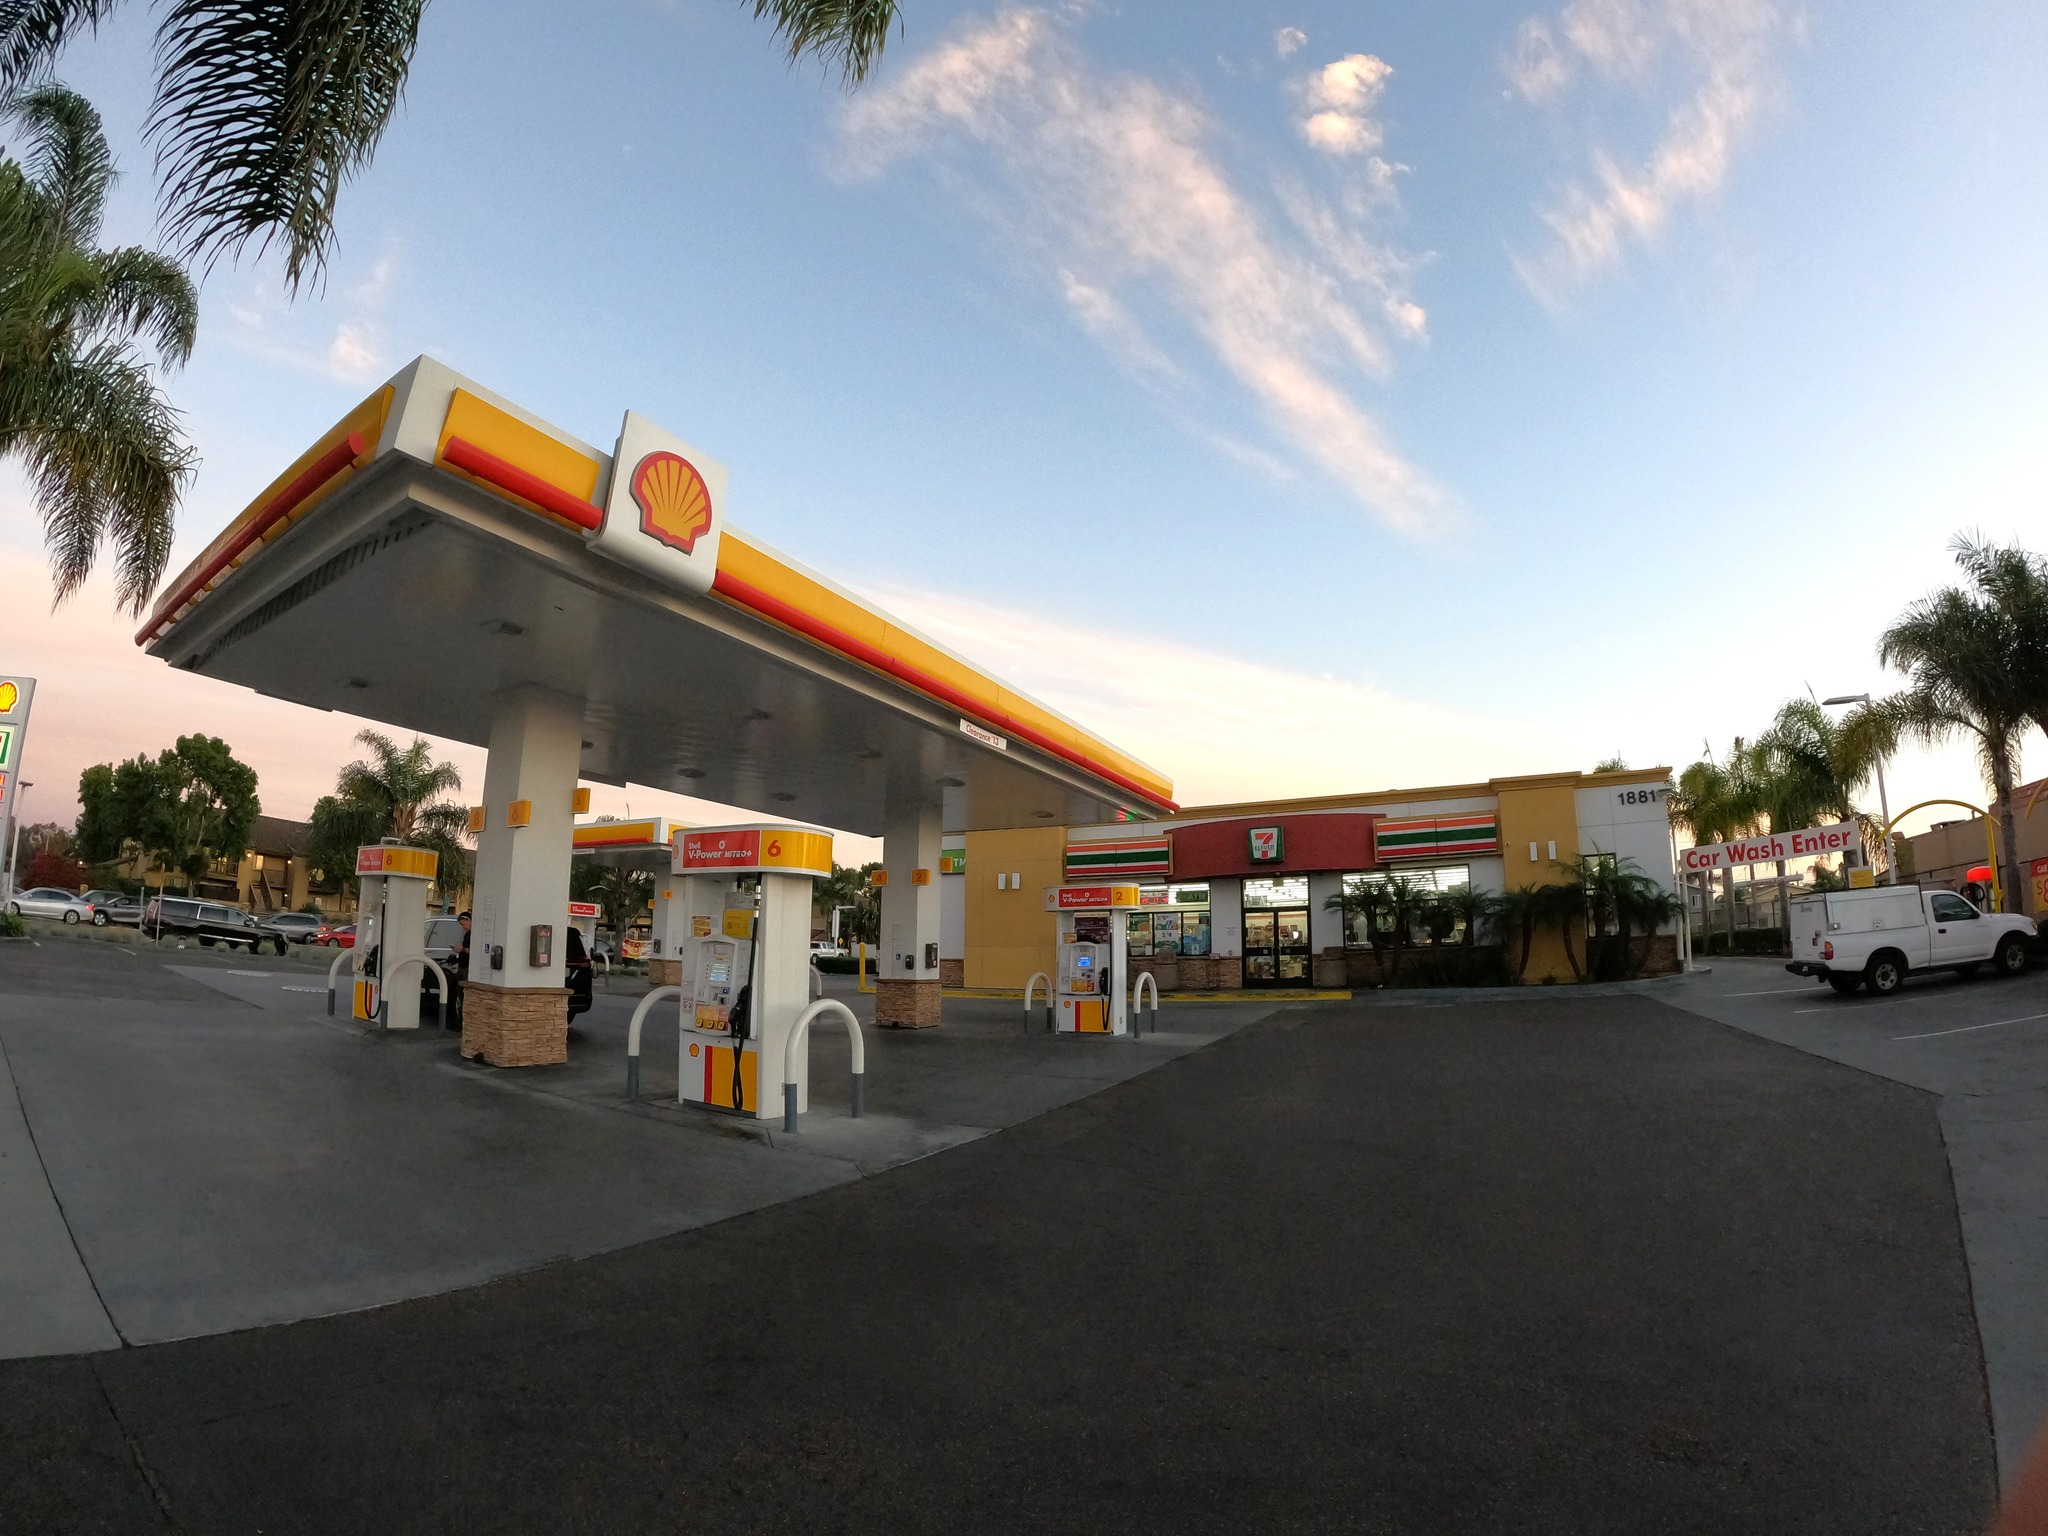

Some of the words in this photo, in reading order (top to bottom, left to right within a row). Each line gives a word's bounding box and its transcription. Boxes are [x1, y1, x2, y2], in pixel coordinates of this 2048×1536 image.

[966, 724, 991, 742] Clearance
[1617, 789, 1656, 805] 1881
[473, 811, 480, 827] 8
[688, 841, 701, 850] Shell
[767, 839, 782, 858] 6
[1686, 849, 1720, 869] Car
[1725, 838, 1785, 864] Wash
[1791, 830, 1852, 854] Enter
[386, 854, 393, 866] 8
[688, 849, 722, 859] V-Power
[2036, 864, 2048, 874] CAR
[1115, 891, 1123, 901] 2
